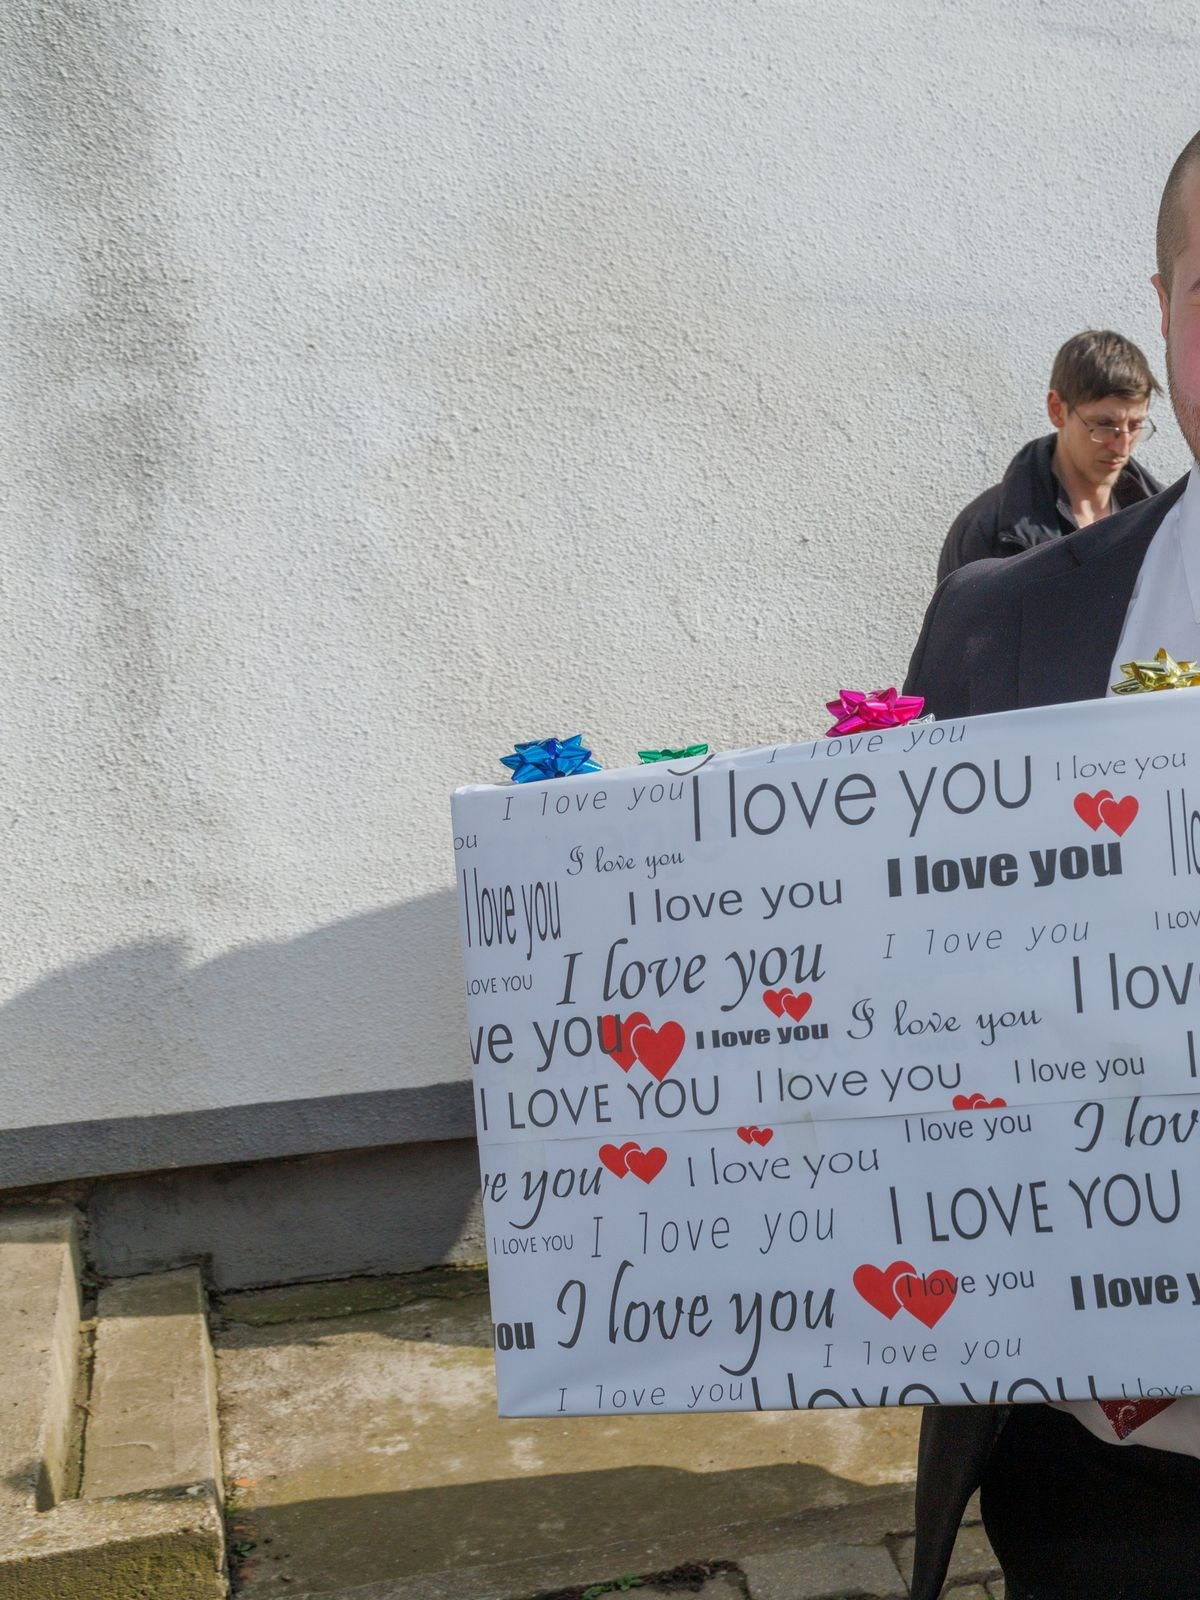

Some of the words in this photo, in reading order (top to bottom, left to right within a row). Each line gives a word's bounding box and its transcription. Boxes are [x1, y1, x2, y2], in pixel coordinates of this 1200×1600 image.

[811, 735, 883, 758] love
[902, 722, 966, 753] you
[1056, 761, 1061, 782] I
[1072, 754, 1127, 780] love
[1134, 752, 1187, 780] you
[502, 796, 515, 822] I
[540, 790, 608, 816] love
[626, 781, 684, 811] you
[692, 774, 702, 843] I
[728, 769, 877, 839] love
[898, 754, 1032, 839] you
[454, 835, 477, 850] ou
[1166, 789, 1177, 877] I
[566, 845, 584, 876] I
[594, 845, 637, 873] love
[644, 852, 685, 880] you
[886, 857, 903, 898] I
[913, 852, 1019, 895] love
[1028, 841, 1123, 888] you
[462, 868, 472, 948] I
[473, 866, 517, 948] love
[520, 880, 562, 962] you
[628, 891, 637, 926] I
[654, 888, 743, 923] love
[760, 878, 843, 920] you
[1154, 911, 1160, 931] I
[882, 933, 896, 960] I
[926, 928, 1003, 956] love
[1024, 921, 1089, 952] you
[467, 978, 497, 995] LOVE
[501, 973, 533, 993] YOU
[555, 951, 584, 1006] I
[602, 937, 707, 1002] love
[719, 943, 826, 1013] you
[1072, 955, 1084, 1014] I
[695, 1030, 705, 1050] I
[711, 1028, 771, 1049] love
[776, 1022, 829, 1046] you
[846, 997, 875, 1040] I
[893, 999, 962, 1036] love
[975, 1009, 1043, 1047] you
[470, 1024, 514, 1064] ve
[531, 1013, 623, 1073] you
[1186, 1030, 1198, 1078] I
[756, 1077, 764, 1104] I
[777, 1067, 869, 1102] love
[885, 1062, 962, 1103] you
[1014, 1059, 1021, 1085] I
[1030, 1058, 1087, 1083] love
[1095, 1056, 1145, 1084] you
[479, 1087, 489, 1131] I
[507, 1083, 612, 1130] LOVE
[626, 1074, 720, 1120] YOU
[904, 1118, 911, 1144] I
[919, 1117, 974, 1143] love
[983, 1113, 1032, 1142] you
[1073, 1101, 1105, 1153] I
[687, 1156, 696, 1188] I
[710, 1146, 791, 1186] love
[802, 1148, 880, 1190] you
[508, 1166, 604, 1230] you
[888, 1185, 903, 1246] I
[926, 1180, 1054, 1243] LOVE
[1067, 1168, 1181, 1230] YOU
[493, 1237, 497, 1255] I
[502, 1236, 538, 1255] LOVE
[541, 1233, 574, 1252] YOU
[590, 1215, 604, 1259] I
[638, 1211, 730, 1255] love
[759, 1207, 834, 1255] you
[905, 1274, 912, 1297] I
[921, 1272, 976, 1297] love
[985, 1270, 1035, 1297] you
[1069, 1275, 1086, 1311] I
[1092, 1273, 1180, 1310] love
[493, 1322, 536, 1351] ou
[556, 1279, 587, 1350] I
[608, 1259, 713, 1345] love
[719, 1287, 836, 1377] you
[823, 1343, 834, 1369] I
[862, 1340, 938, 1366] love
[960, 1337, 1022, 1366] you
[556, 1387, 568, 1413] I
[595, 1384, 666, 1409] love
[686, 1382, 743, 1409] you
[1138, 1378, 1192, 1398] love
